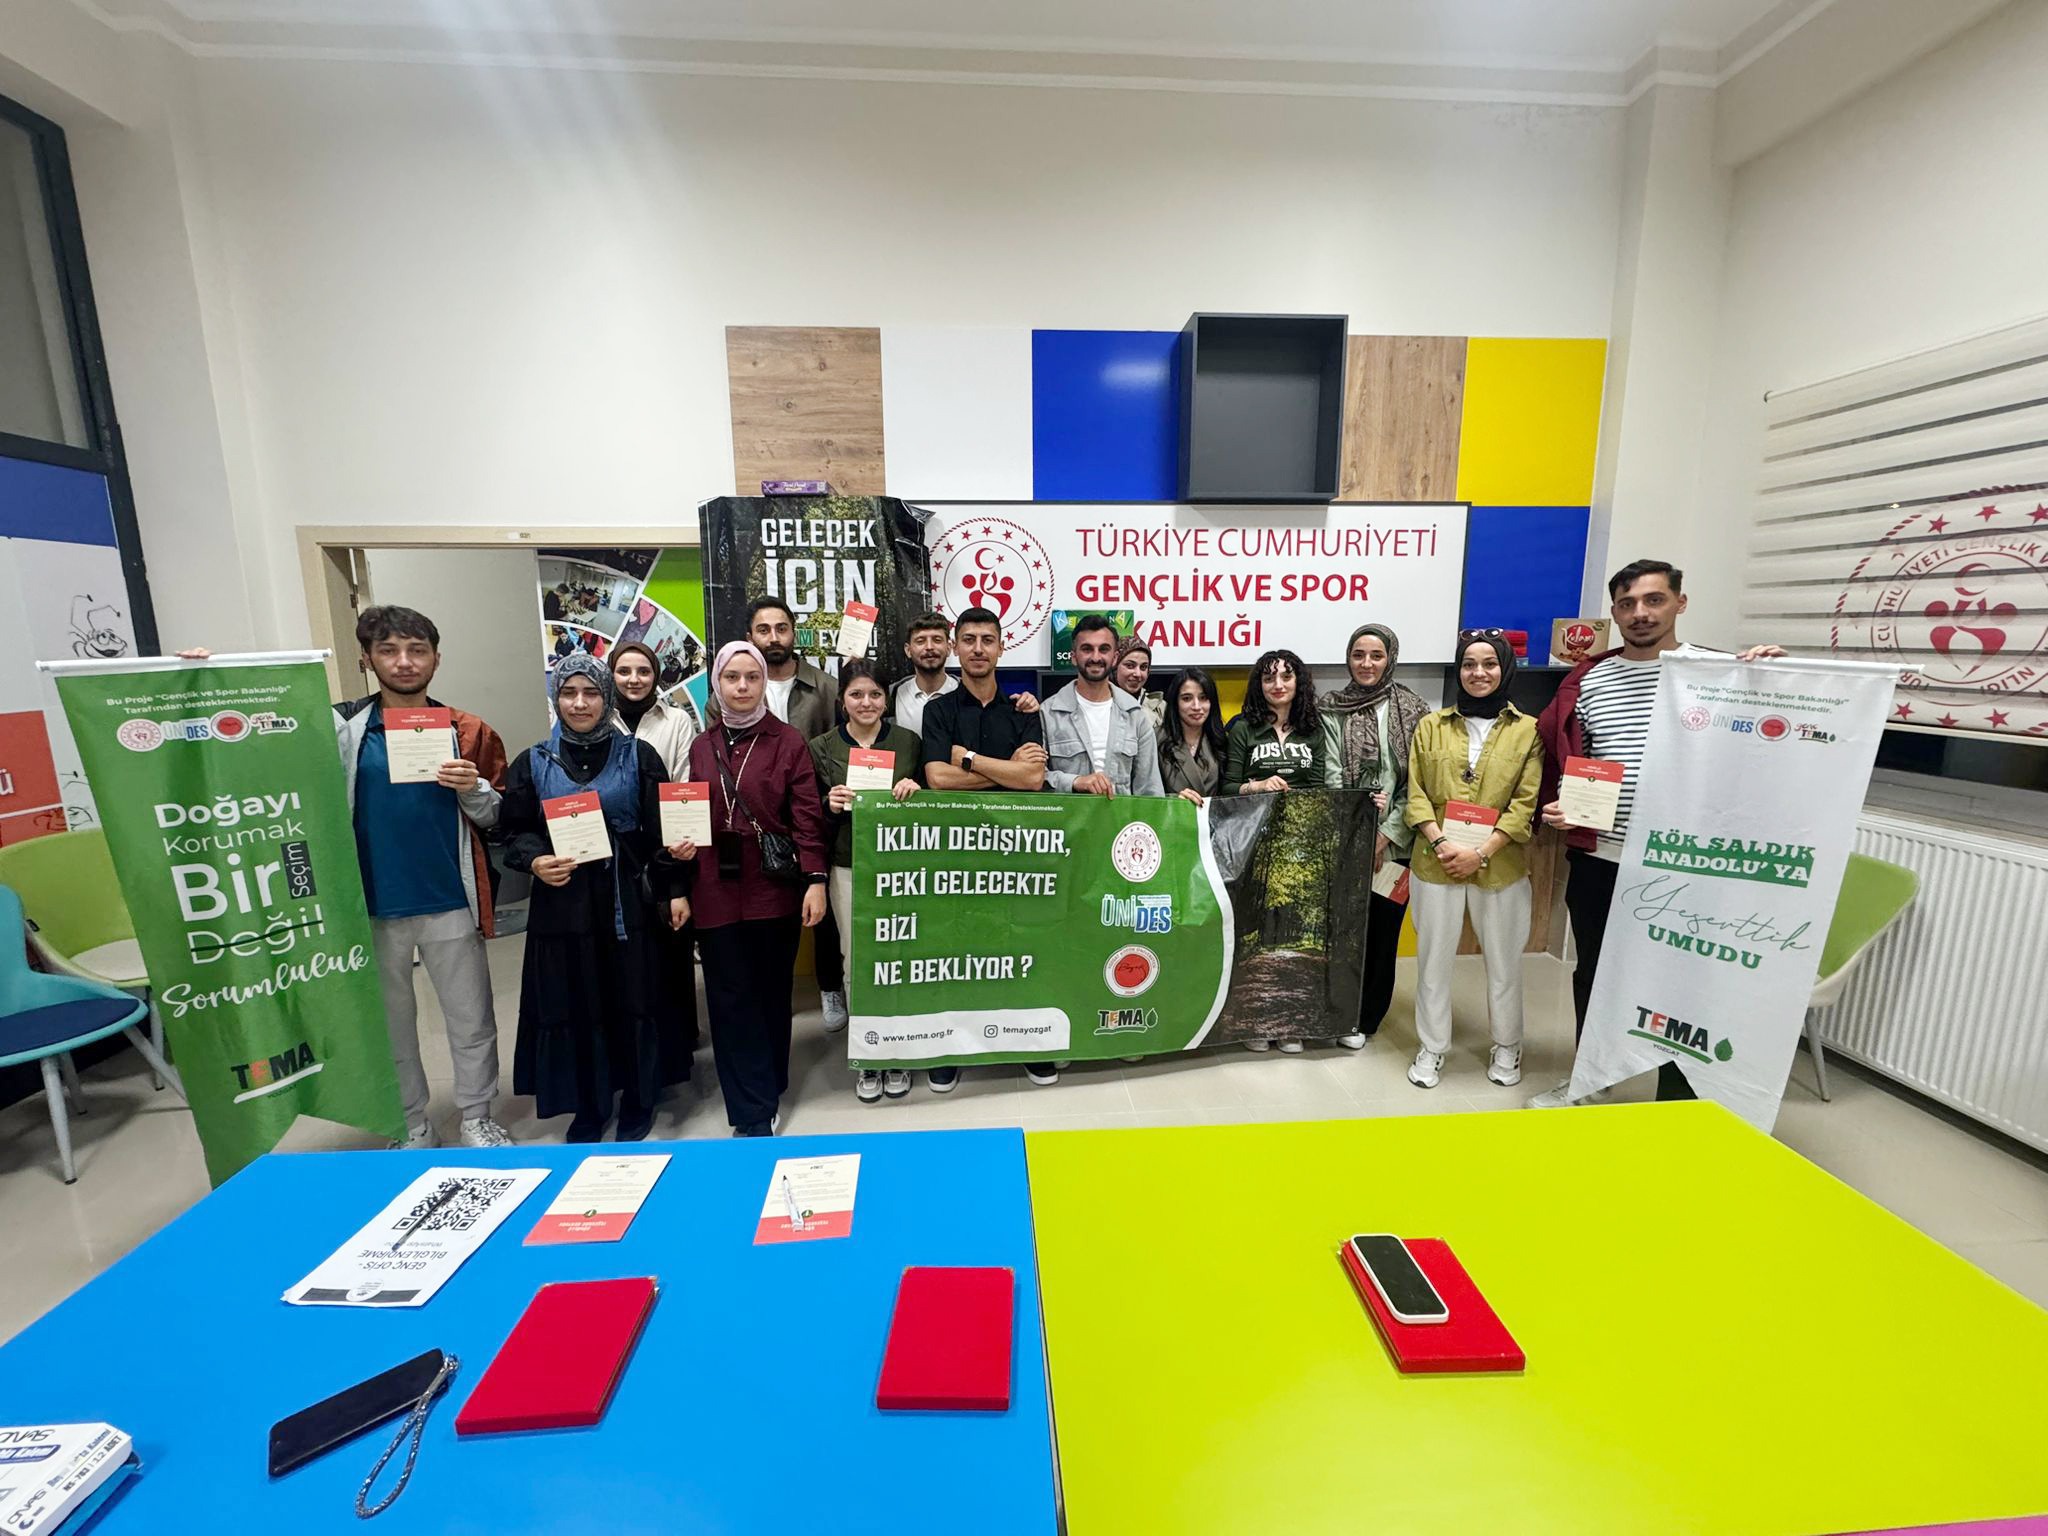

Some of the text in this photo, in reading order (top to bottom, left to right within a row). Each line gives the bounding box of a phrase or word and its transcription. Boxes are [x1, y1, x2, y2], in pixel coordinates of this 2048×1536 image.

[761, 518, 876, 548] GELECEK
[1075, 523, 1437, 556] TÜRKİYE CUMHURİYETİ
[763, 549, 878, 623] İÇİN
[1075, 568, 1369, 610] GENÇLİK VE SPOR
[107, 698, 122, 706] Bu
[125, 695, 153, 704] Proje
[216, 688, 238, 697] Spor
[1700, 686, 1720, 694] Proje
[1774, 692, 1799, 701] Spor
[1301, 759, 1311, 768] 92
[154, 792, 301, 828] Doğayı
[162, 818, 305, 856] Korumak
[876, 822, 1071, 857] İKLİM DEĞİŞİYOR,
[1649, 829, 1815, 859] KÖK SALDIK
[171, 842, 311, 922] Bir Seçim
[876, 867, 1057, 897] PEKİ GELECEKTE
[187, 904, 325, 965] Değil
[875, 912, 917, 942] BİZİ
[1648, 924, 1763, 969] UMUDU
[162, 944, 368, 1018] Sorumluluk
[874, 960, 902, 986] NE
[909, 954, 1014, 984] BEKLİYOR
[1003, 1024, 1052, 1036] temayozgat
[1099, 1009, 1143, 1027] TEMA
[1637, 1005, 1708, 1052] TEMA
[883, 1029, 953, 1043] www.tema.org.tr
[231, 1042, 315, 1089] TEMA
[357, 1249, 448, 1260] BİLGİLENDİRME
[363, 1261, 392, 1271] OFİS
[392, 1260, 427, 1270] GENÇ
